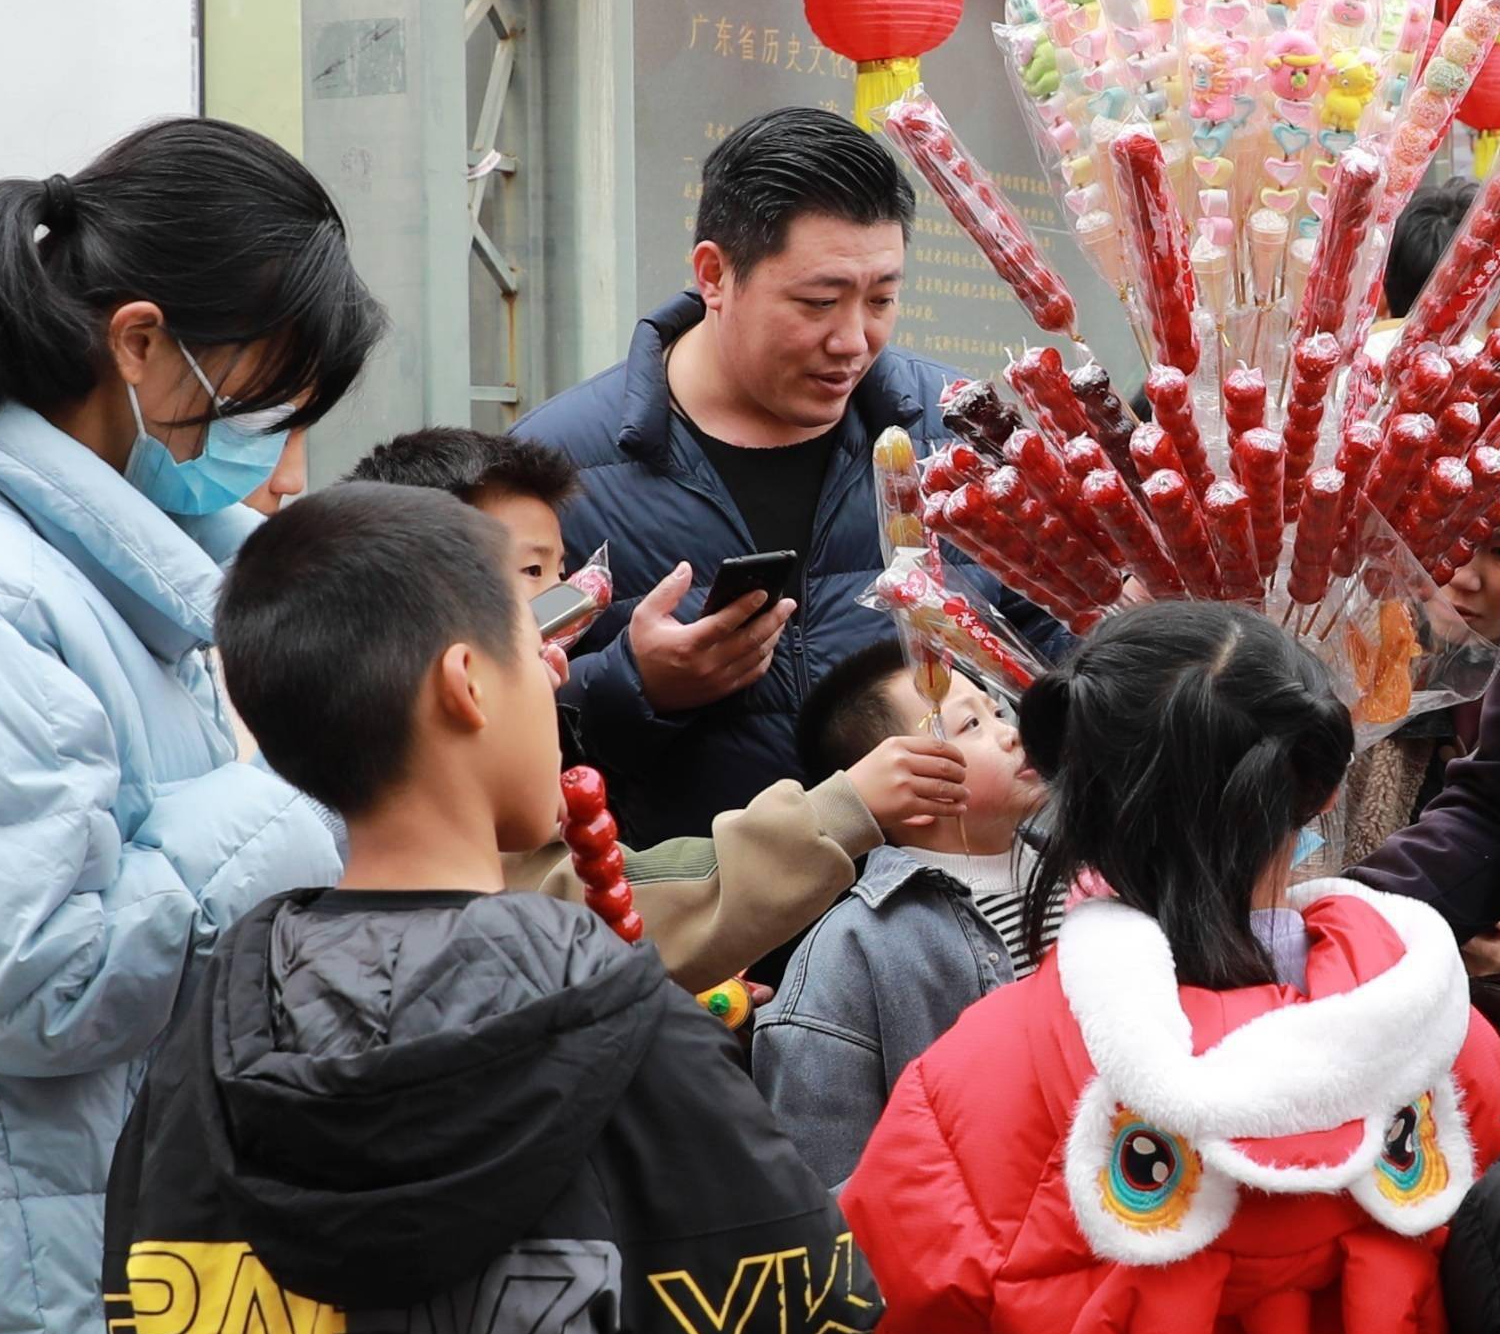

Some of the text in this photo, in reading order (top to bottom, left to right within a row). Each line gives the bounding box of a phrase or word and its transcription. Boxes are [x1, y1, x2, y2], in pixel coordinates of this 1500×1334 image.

[689, 14, 857, 82] 广东省历史文化
